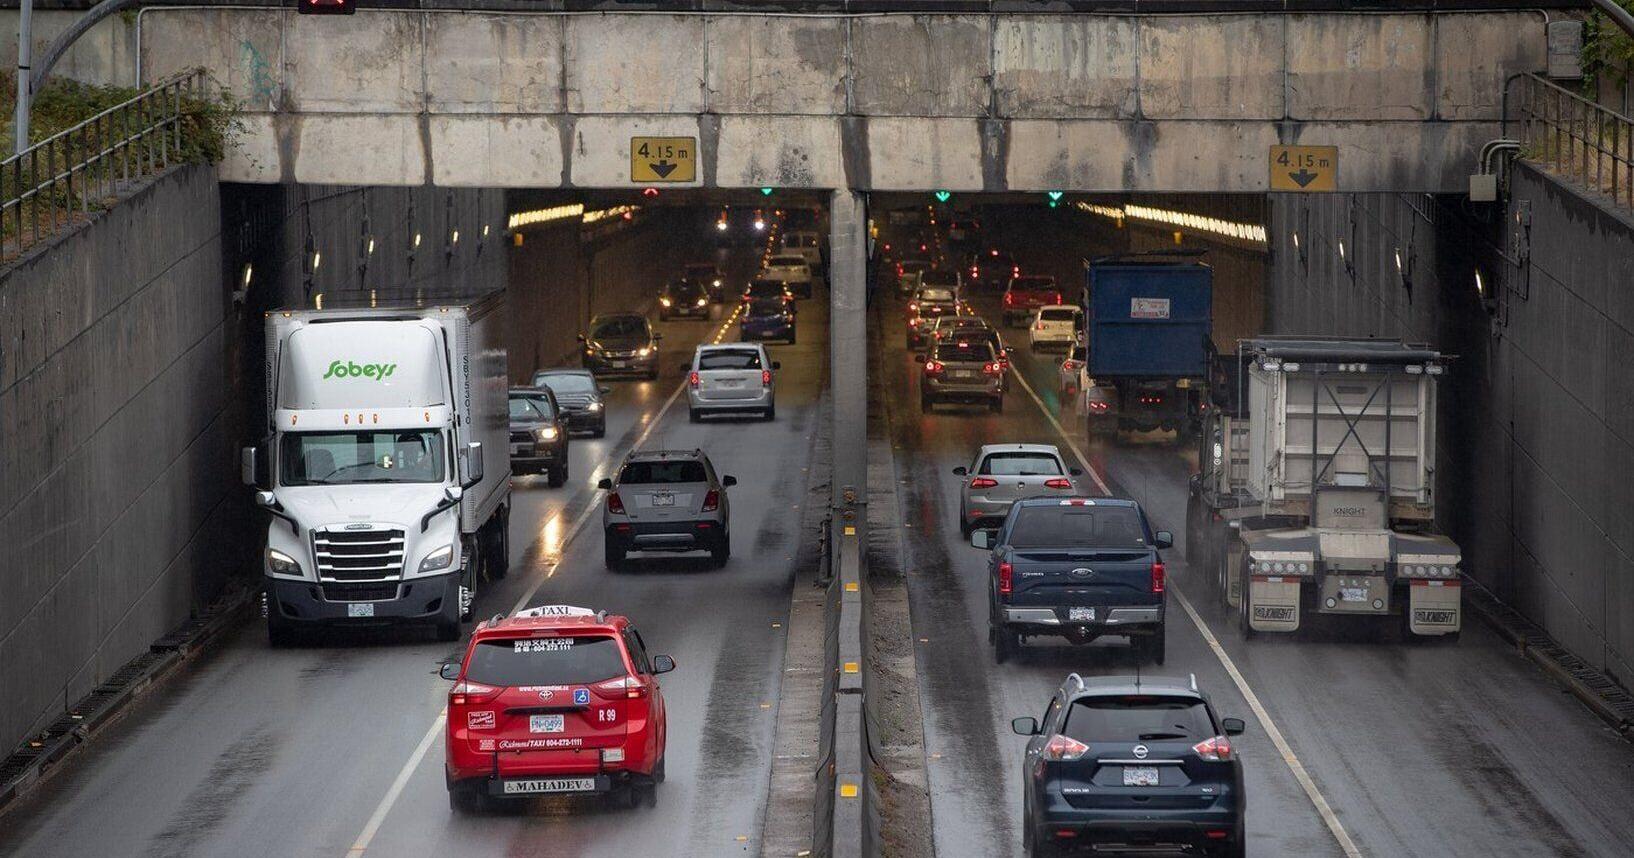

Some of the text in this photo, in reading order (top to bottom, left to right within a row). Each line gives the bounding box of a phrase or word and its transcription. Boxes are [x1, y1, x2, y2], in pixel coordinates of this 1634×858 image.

[638, 143, 688, 158] 4.15 m
[1277, 151, 1329, 168] 4.15 m
[323, 360, 397, 381] Sobeys
[540, 606, 569, 615] TAXI
[599, 709, 616, 721] R 99
[516, 780, 583, 791] MAHADEV
